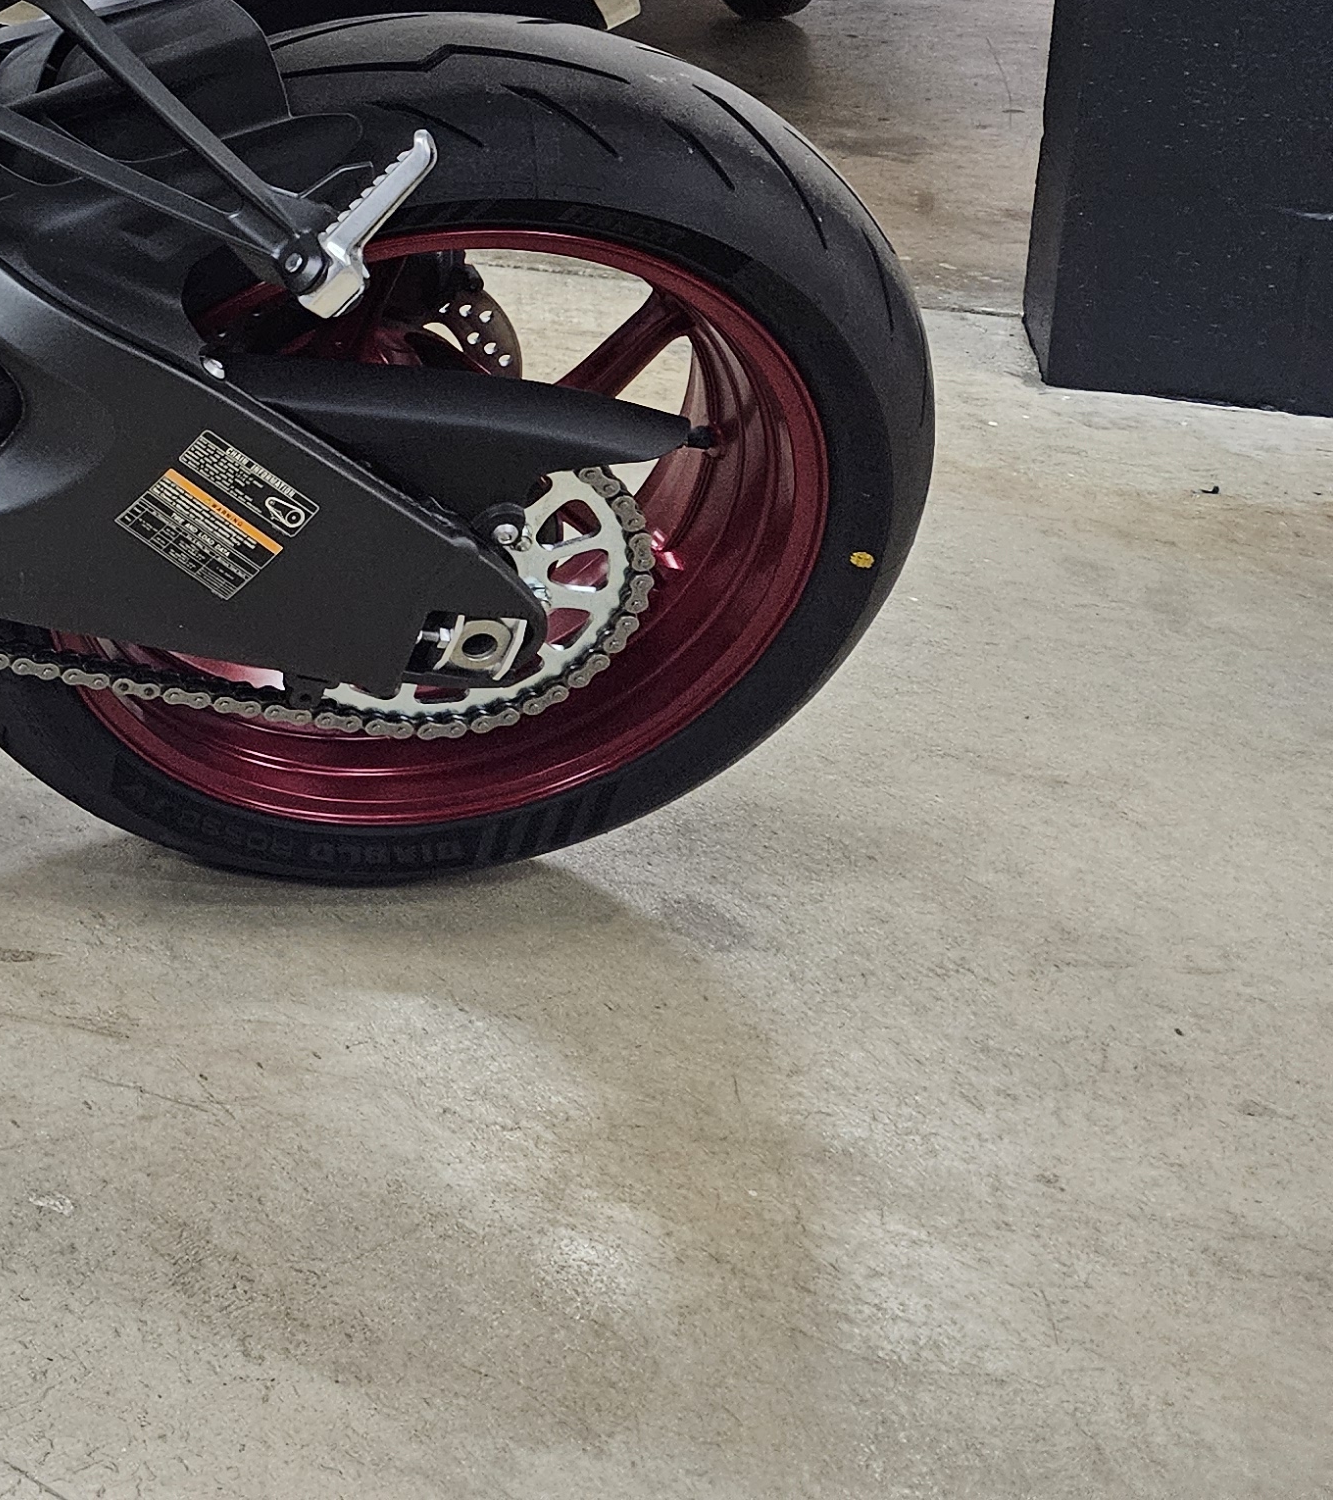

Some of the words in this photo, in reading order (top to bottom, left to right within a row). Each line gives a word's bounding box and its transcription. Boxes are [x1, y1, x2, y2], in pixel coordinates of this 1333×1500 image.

[226, 447, 250, 466] CHAIN
[250, 463, 296, 499] INFORMATION
[211, 502, 244, 529] WARNING
[184, 522, 199, 535] AND
[198, 528, 215, 546] LOAD
[214, 540, 231, 558] DATA
